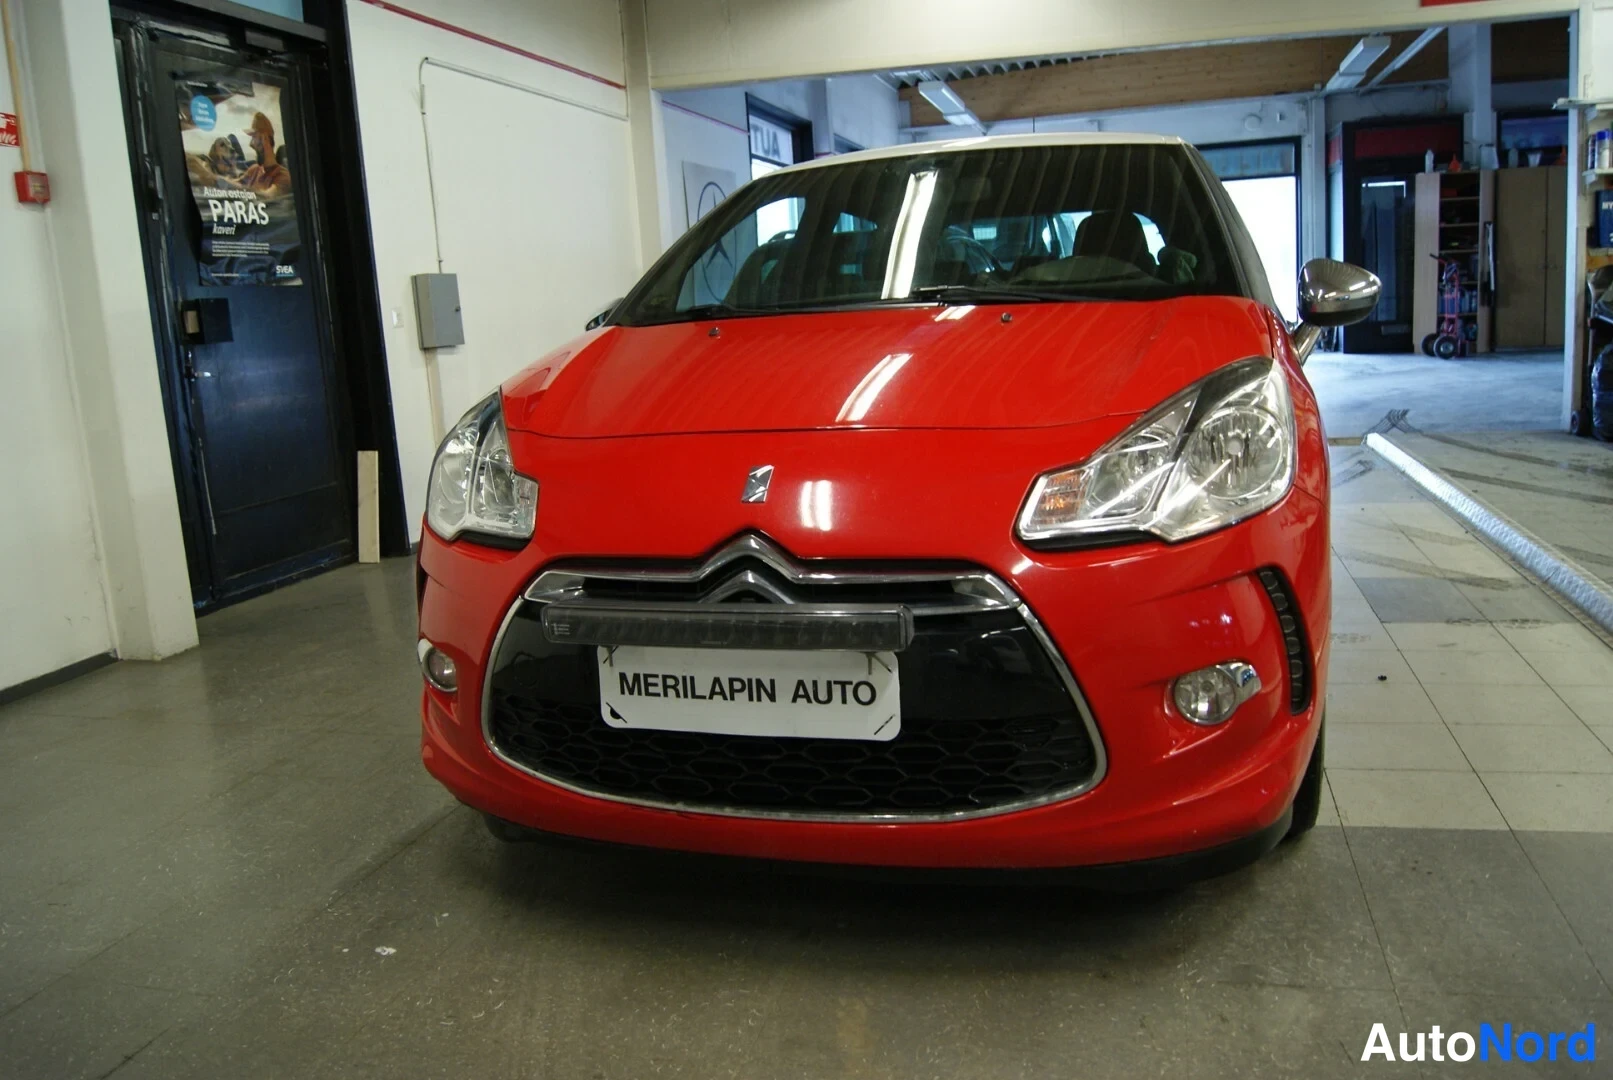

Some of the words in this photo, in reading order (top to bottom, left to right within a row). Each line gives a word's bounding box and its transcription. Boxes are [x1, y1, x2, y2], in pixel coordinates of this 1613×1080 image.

[204, 186, 228, 198] Auton
[229, 188, 257, 202] ostajan
[208, 199, 270, 225] PARAS
[212, 223, 237, 235] kaveri
[275, 265, 294, 274] SVEA
[618, 671, 777, 704] MERILAPIN
[790, 679, 877, 706] AUTO
